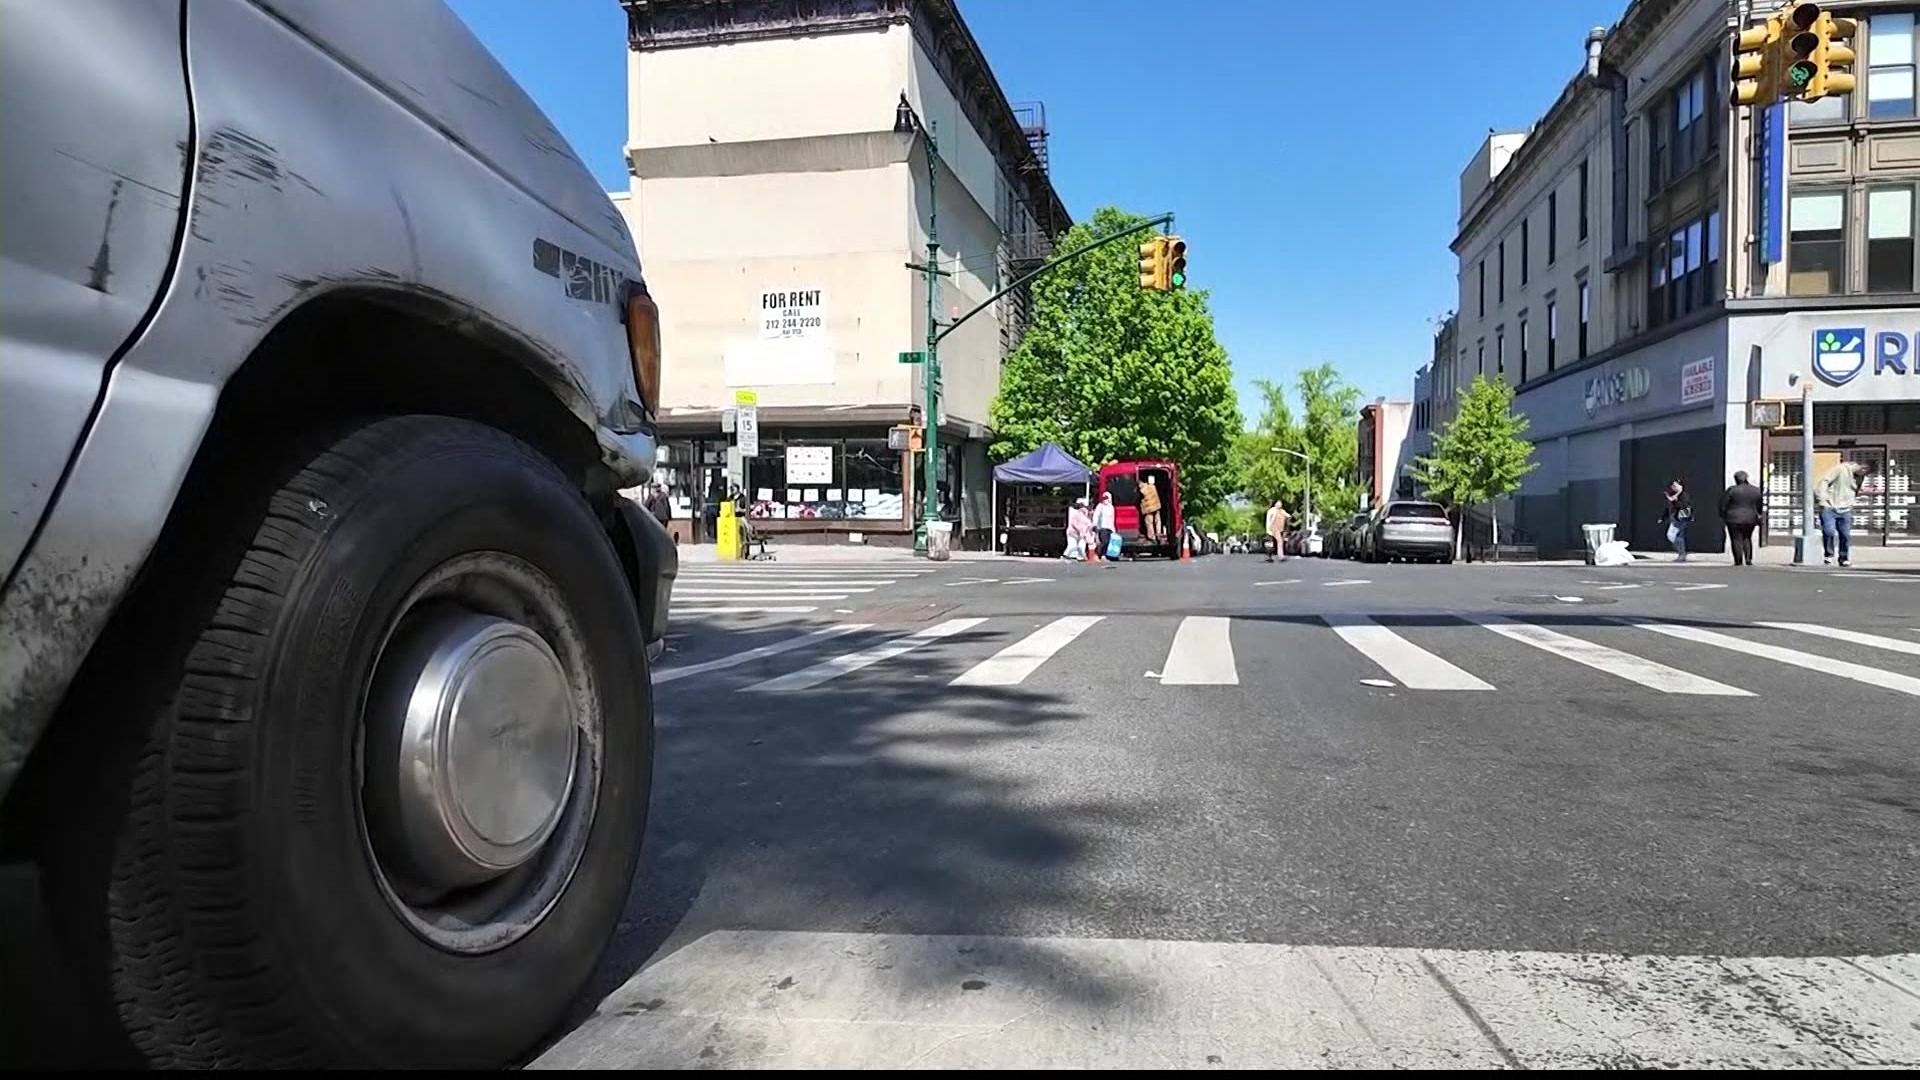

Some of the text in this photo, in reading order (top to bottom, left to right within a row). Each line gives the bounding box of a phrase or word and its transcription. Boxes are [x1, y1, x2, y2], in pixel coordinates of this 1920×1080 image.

[762, 290, 822, 309] FOR RENT
[782, 309, 801, 317] CALL
[742, 420, 753, 431] 15
